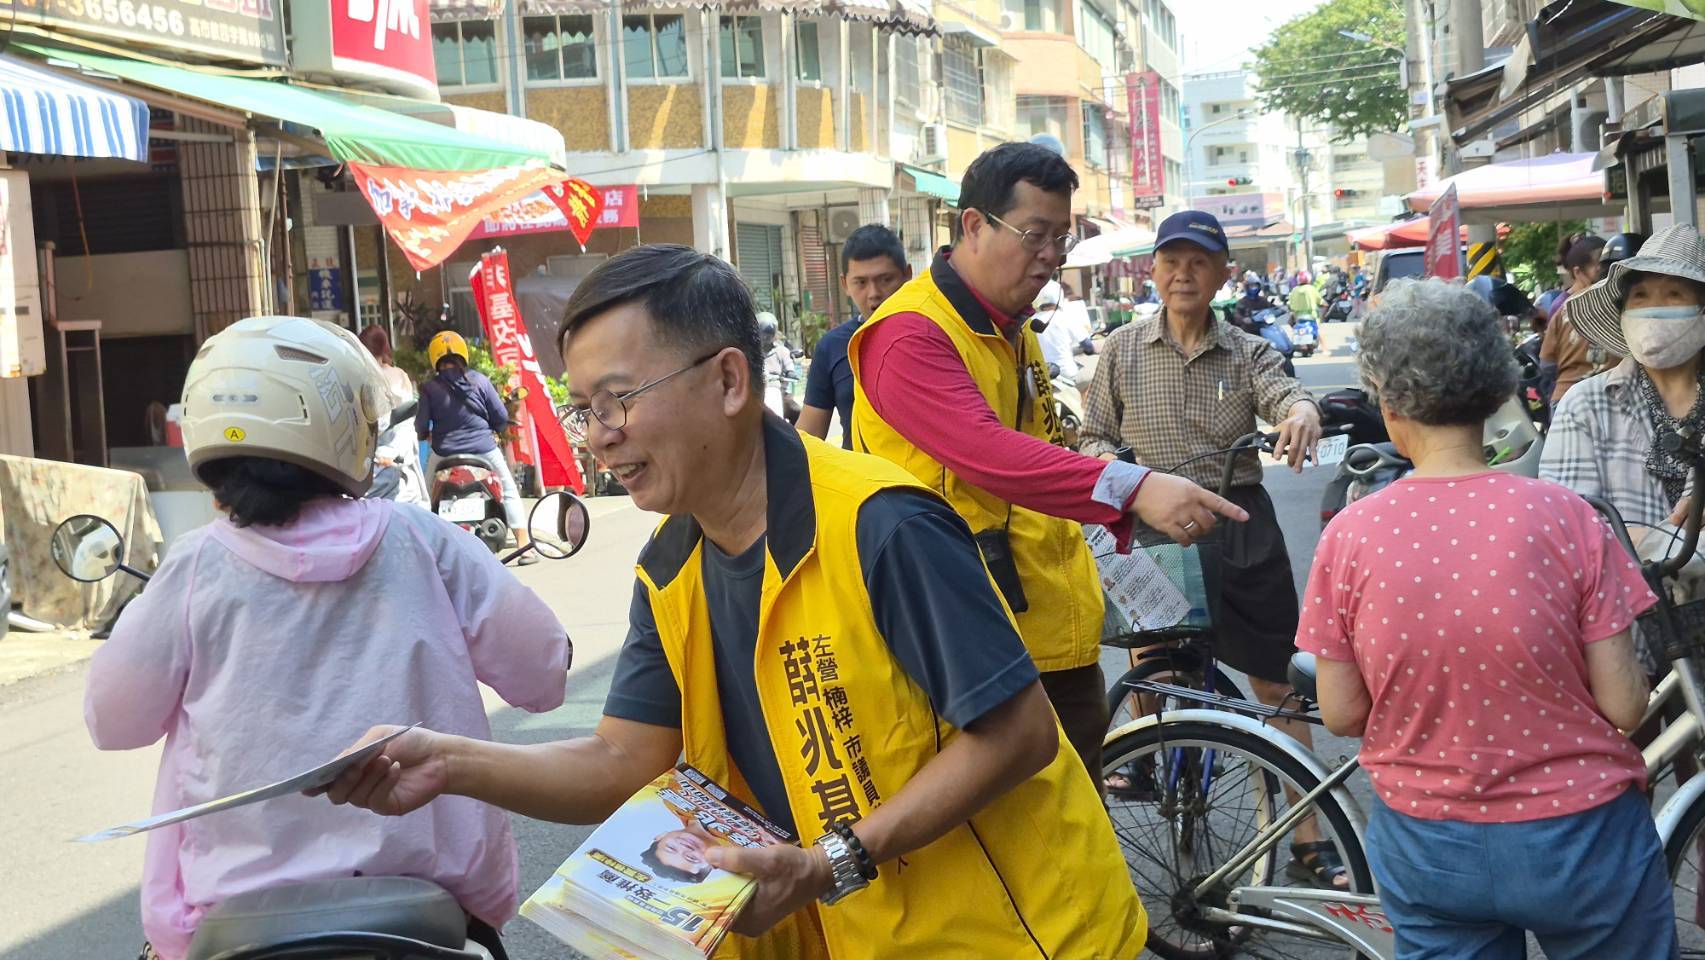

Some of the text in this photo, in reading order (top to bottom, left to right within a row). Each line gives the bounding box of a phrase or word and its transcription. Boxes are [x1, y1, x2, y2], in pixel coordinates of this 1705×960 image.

[230, 429, 239, 439] A
[812, 634, 838, 682] 左營
[822, 686, 854, 734] 楠梓
[658, 906, 705, 933] 15
